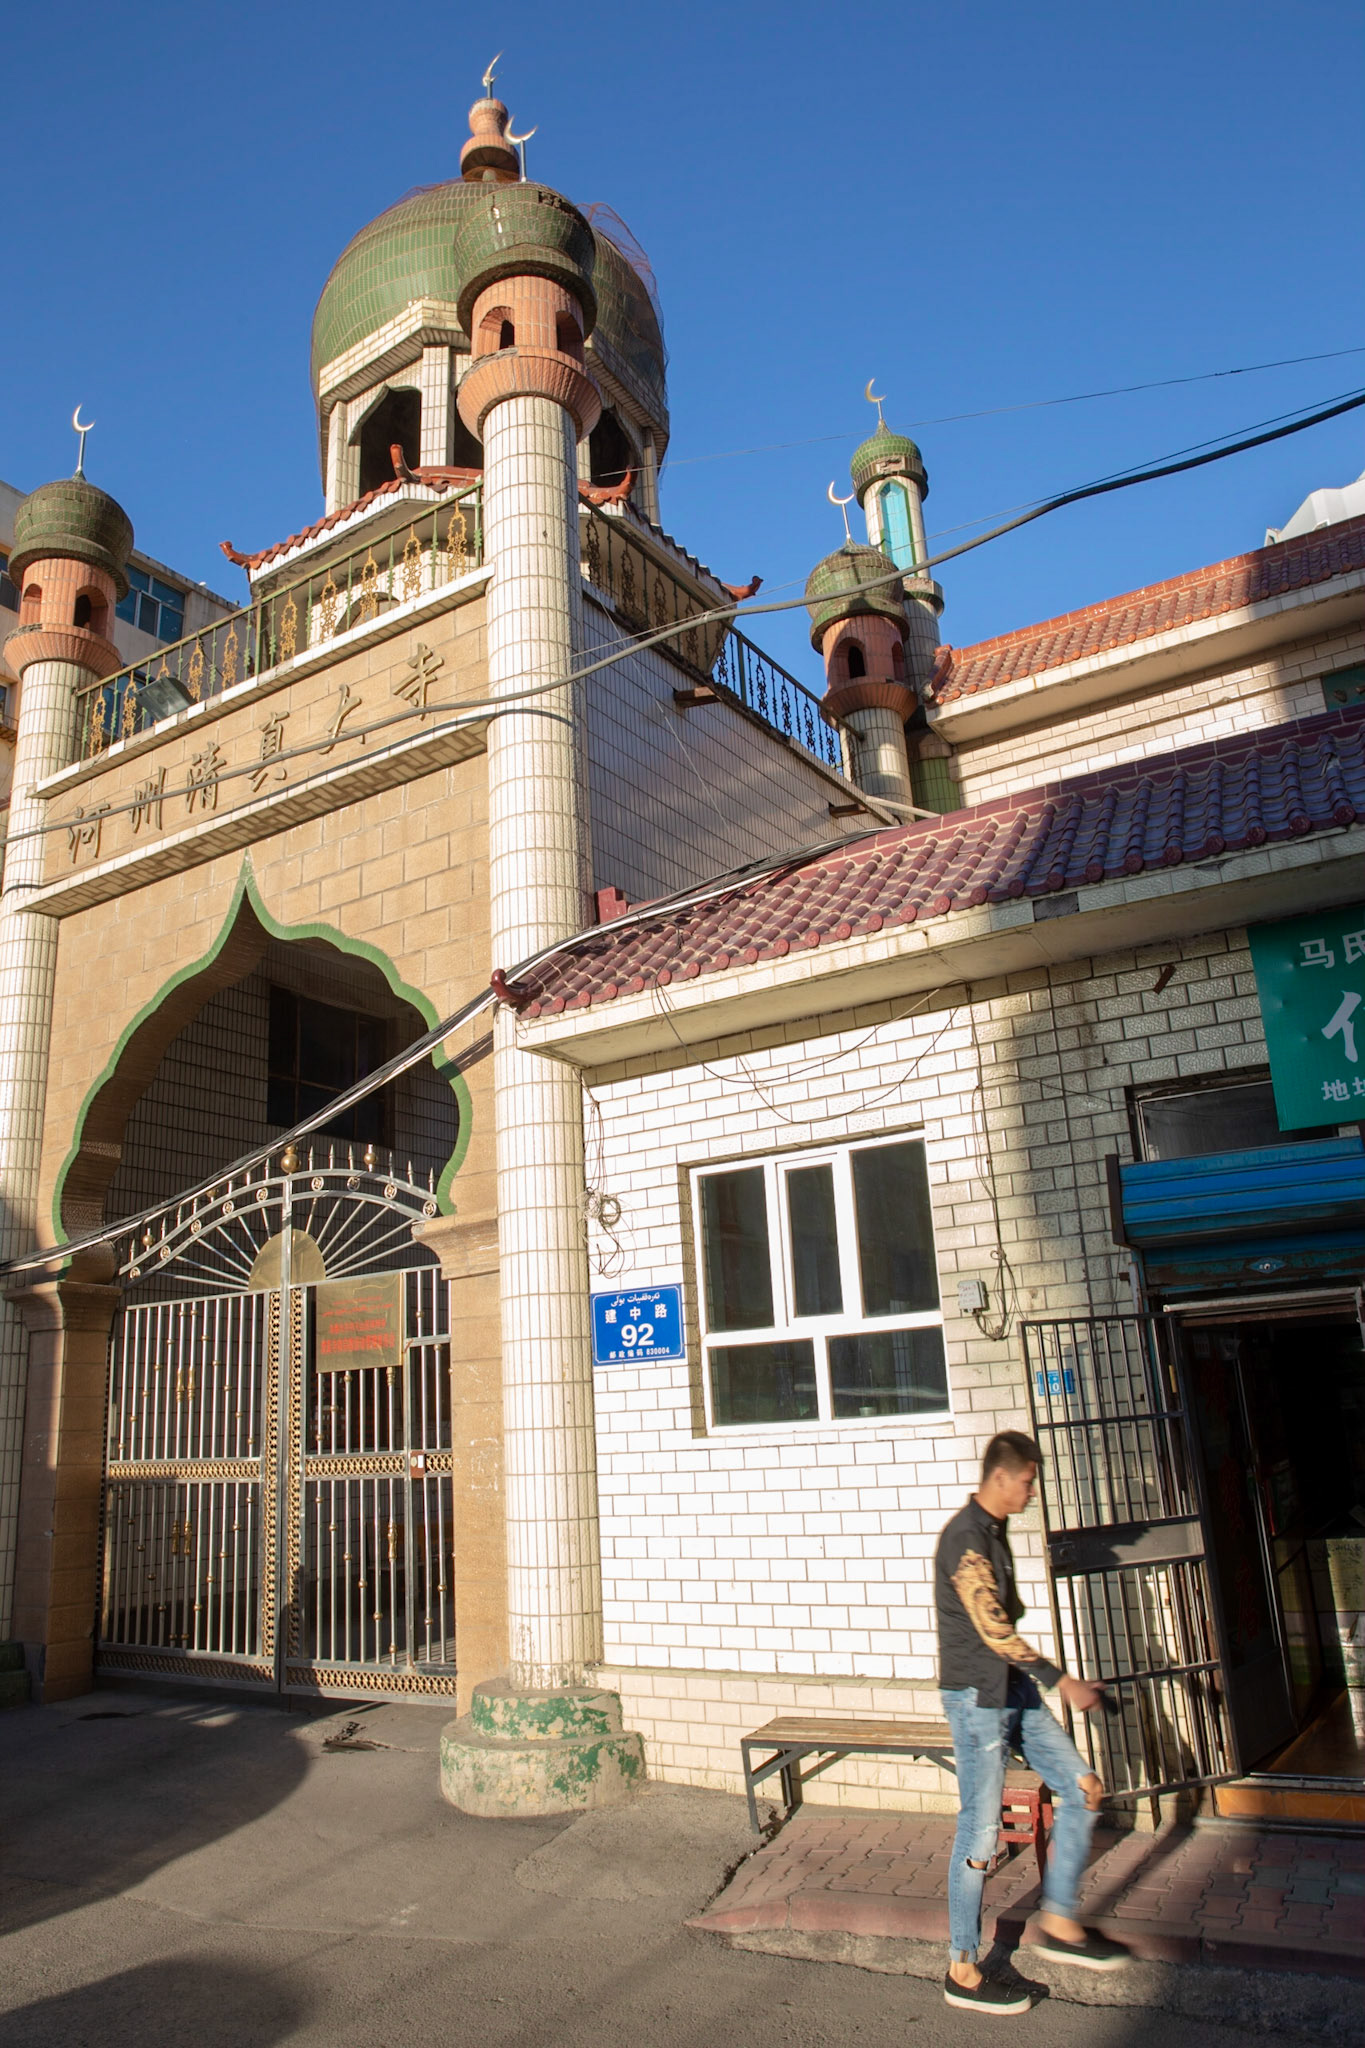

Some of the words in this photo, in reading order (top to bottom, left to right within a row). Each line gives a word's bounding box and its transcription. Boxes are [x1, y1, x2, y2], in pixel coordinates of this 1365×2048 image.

[68, 642, 444, 864] 河州清真大寺
[605, 1303, 667, 1323] 建中路
[621, 1323, 654, 1347] 92
[646, 1347, 670, 1355] 830004
